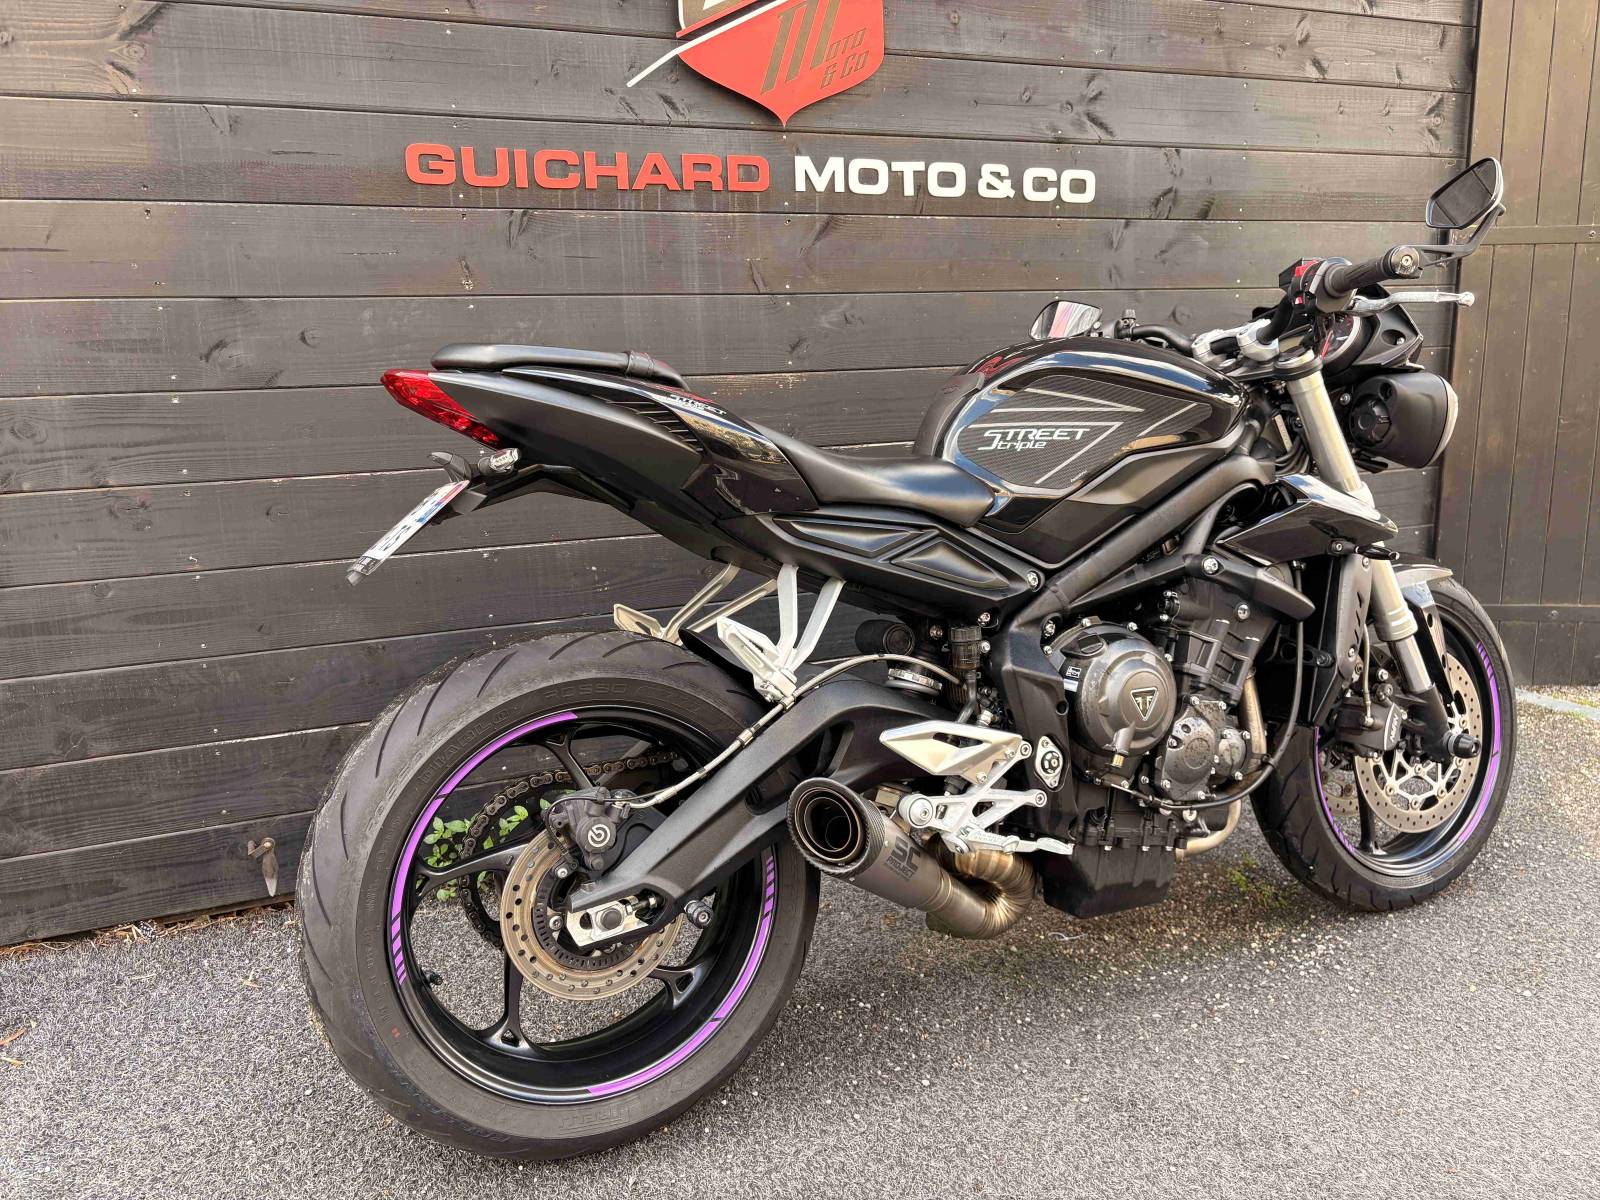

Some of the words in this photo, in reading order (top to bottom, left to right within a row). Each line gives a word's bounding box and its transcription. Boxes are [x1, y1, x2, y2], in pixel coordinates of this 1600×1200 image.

[405, 142, 771, 193] GUICHARD
[794, 155, 967, 198] MOTO
[977, 428, 1092, 451] STREET
